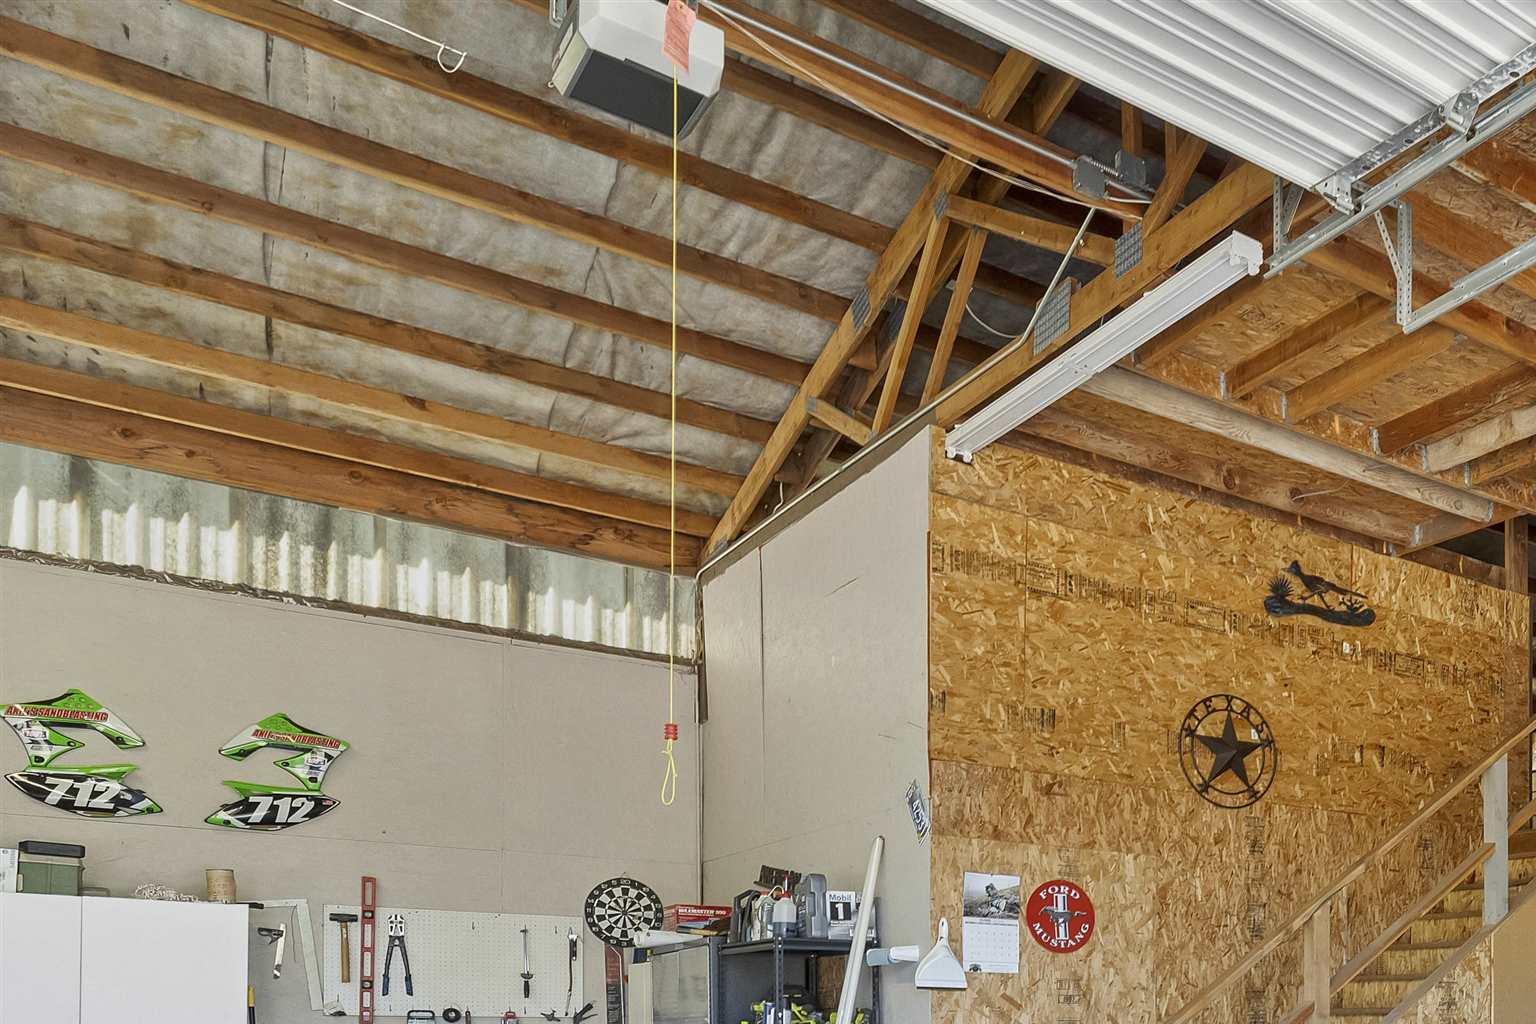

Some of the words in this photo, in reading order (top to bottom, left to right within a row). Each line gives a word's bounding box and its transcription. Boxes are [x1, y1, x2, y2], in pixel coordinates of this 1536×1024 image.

[1188, 694, 1268, 735] TEXAS
[44, 776, 122, 810] 712
[247, 796, 315, 823] 712
[829, 893, 852, 901] Mobil
[1039, 885, 1081, 900] FORD
[835, 902, 845, 920] 1
[1032, 922, 1090, 948] MUSTANG
